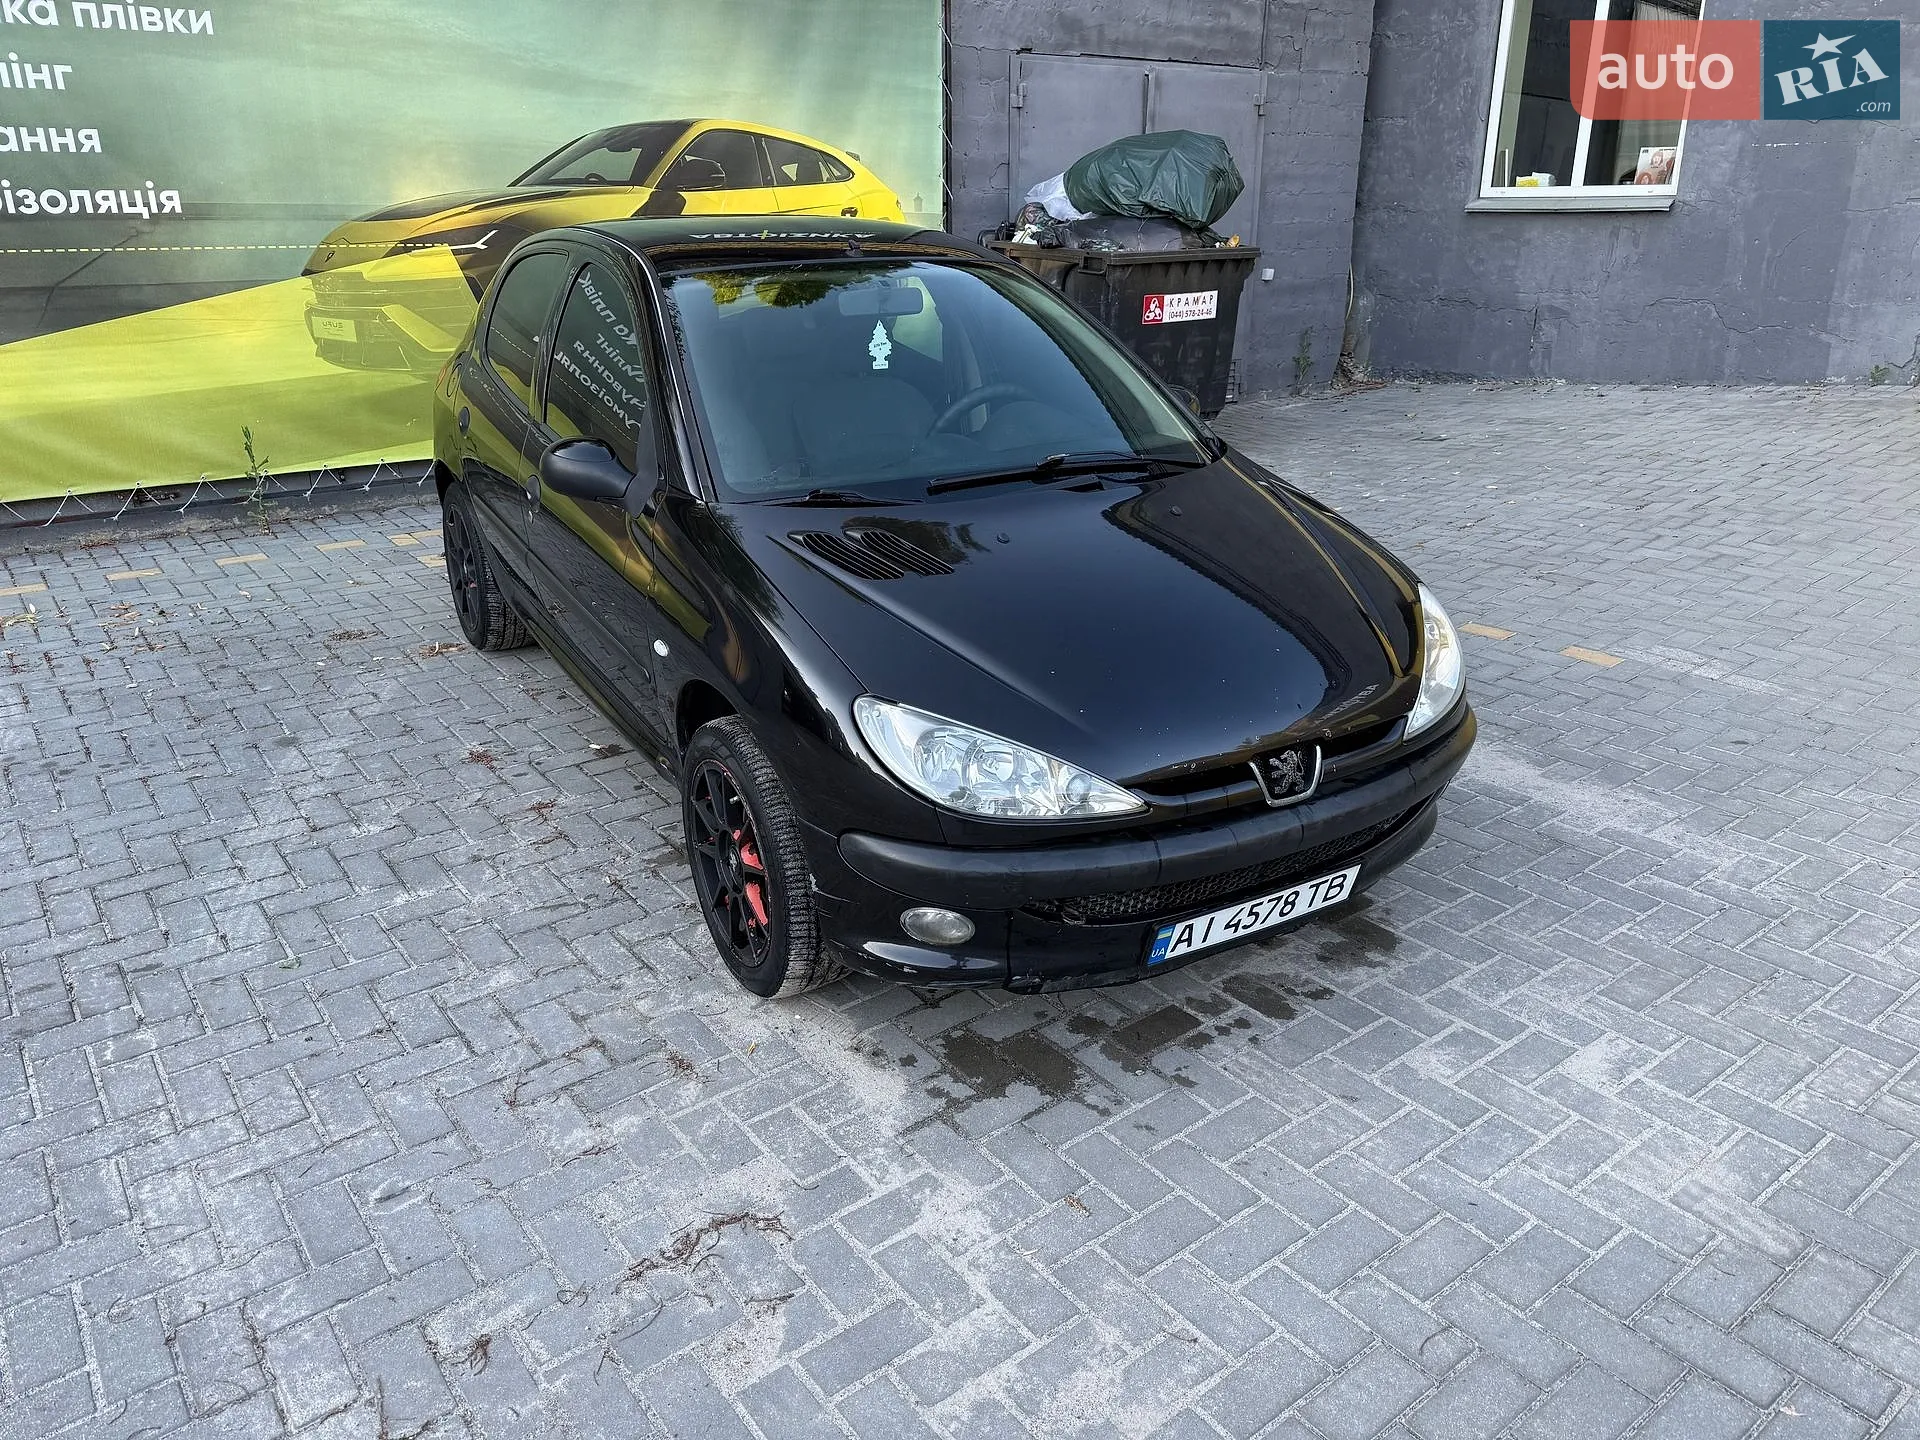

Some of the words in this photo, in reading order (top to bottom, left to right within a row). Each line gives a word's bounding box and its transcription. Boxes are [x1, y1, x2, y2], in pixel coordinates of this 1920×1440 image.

[0, 0, 59, 26] ка
[72, 0, 215, 35] плівки
[0, 179, 182, 219] ізоляція
[1169, 916, 1215, 953] AI
[1223, 890, 1301, 934] 4578
[1307, 873, 1348, 909] TB
[1151, 947, 1166, 959] UA
